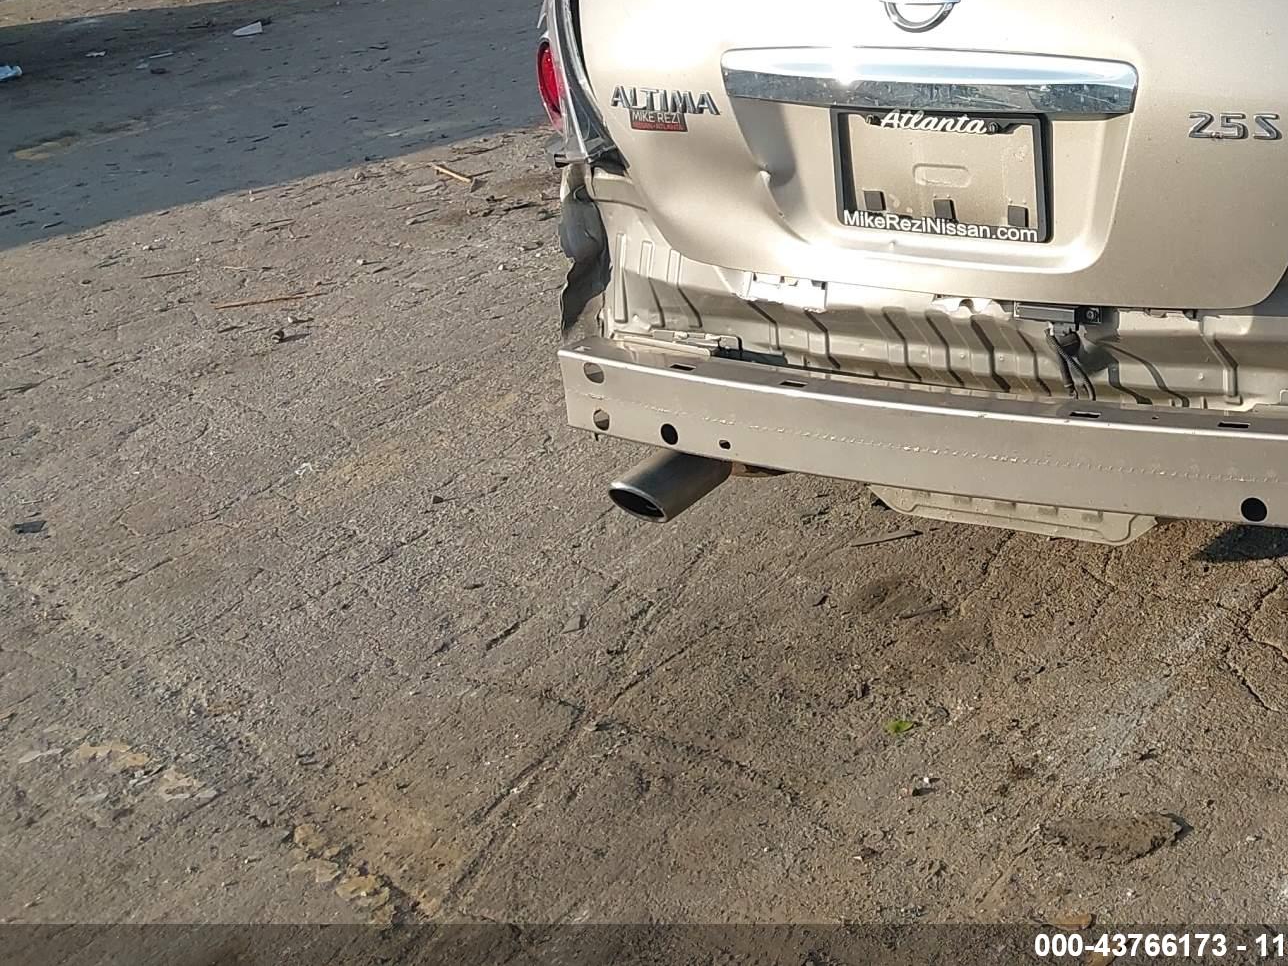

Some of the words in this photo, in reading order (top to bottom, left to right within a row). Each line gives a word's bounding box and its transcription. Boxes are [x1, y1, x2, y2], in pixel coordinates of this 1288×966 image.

[610, 85, 721, 115] ALTIMA
[632, 110, 656, 123] MIKE
[657, 112, 681, 124] REZI
[880, 110, 988, 135] Atlanta
[843, 209, 1039, 242] MikeReziNissan.com
